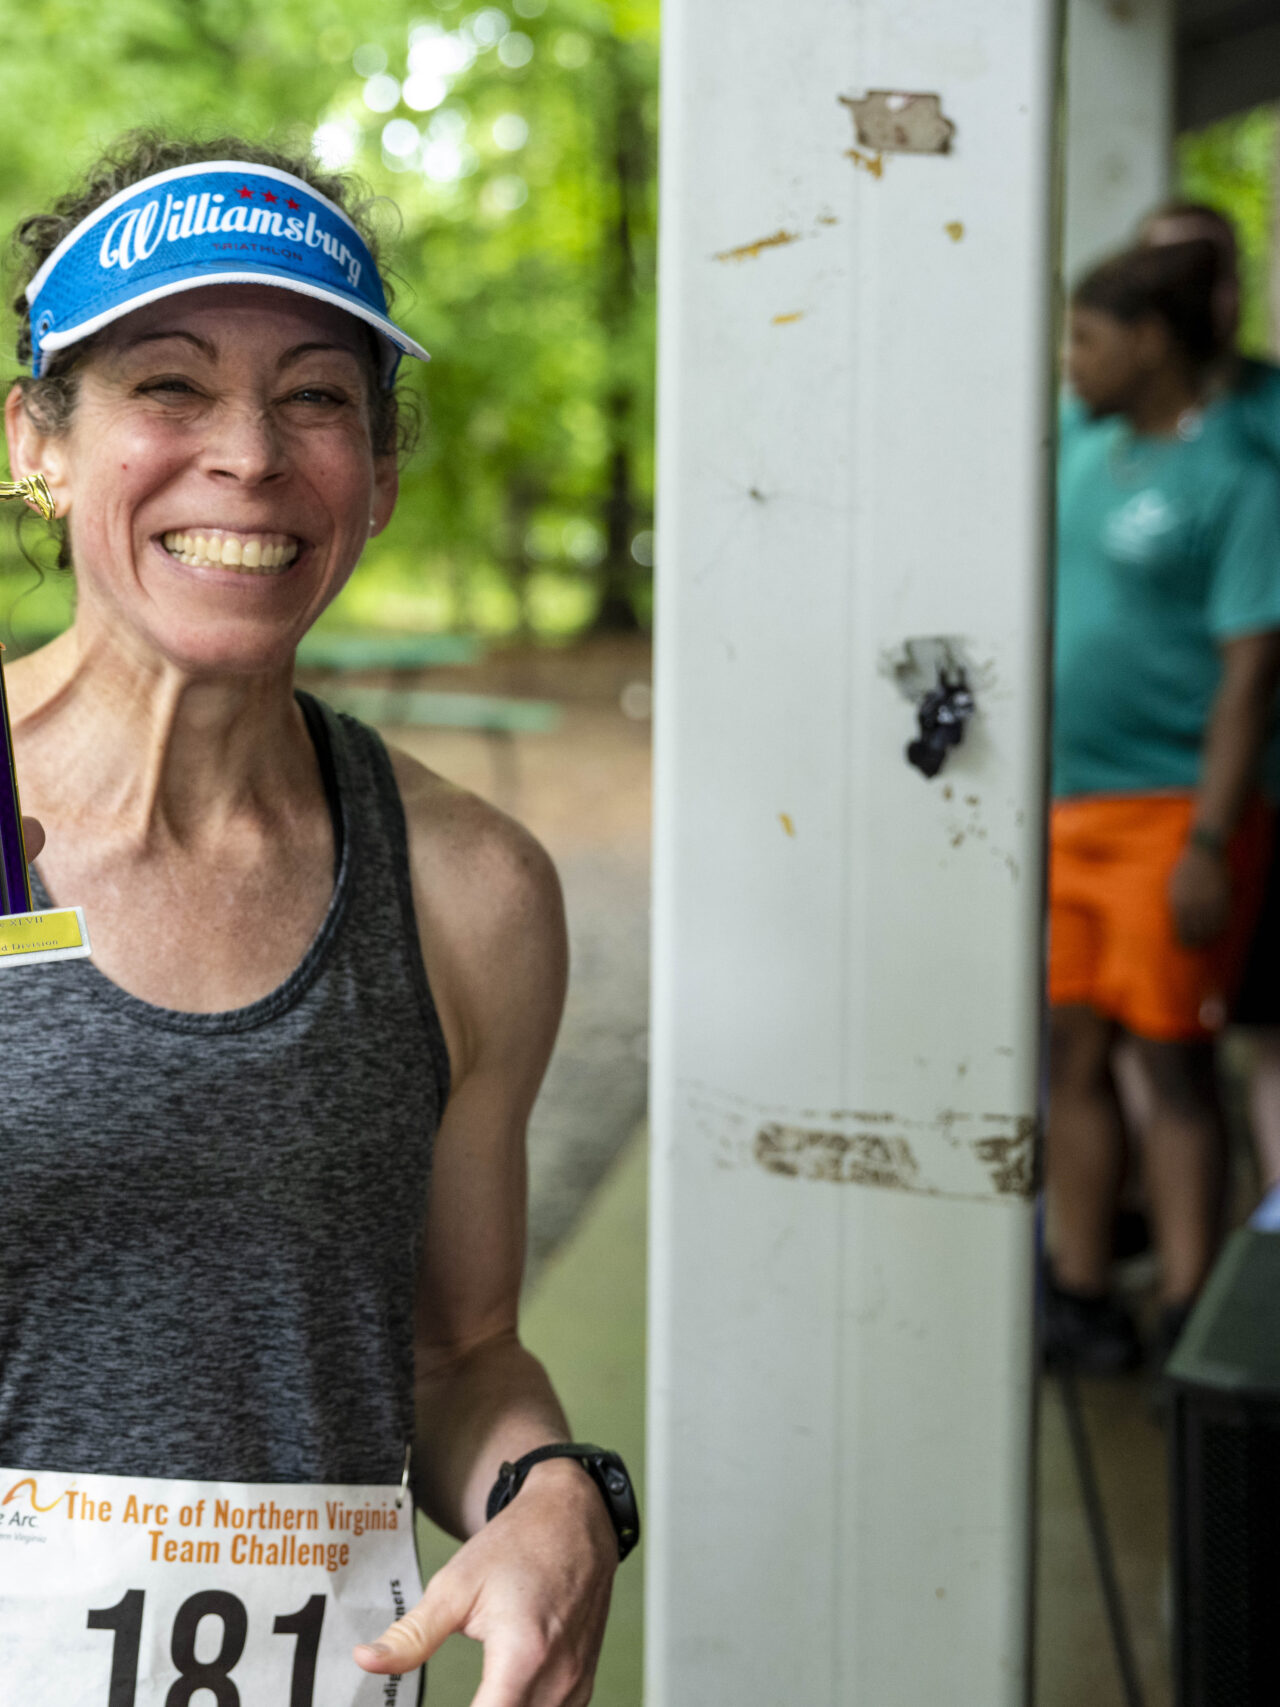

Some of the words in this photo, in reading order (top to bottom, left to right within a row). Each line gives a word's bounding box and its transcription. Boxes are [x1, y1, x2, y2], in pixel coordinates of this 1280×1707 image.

[99, 193, 362, 287] Williamsburg
[212, 243, 303, 261] TRIATHLON
[12, 939, 58, 950] Division
[8, 1511, 38, 1528] Arc
[65, 1490, 112, 1522] The
[122, 1494, 169, 1526] Arc
[178, 1499, 205, 1528] of
[214, 1499, 319, 1531] Northern
[325, 1501, 398, 1536] Virginia
[14, 1532, 47, 1545] Virginia
[148, 1530, 221, 1565] Team
[230, 1533, 350, 1573] Challenge
[86, 1589, 327, 1707] 181
